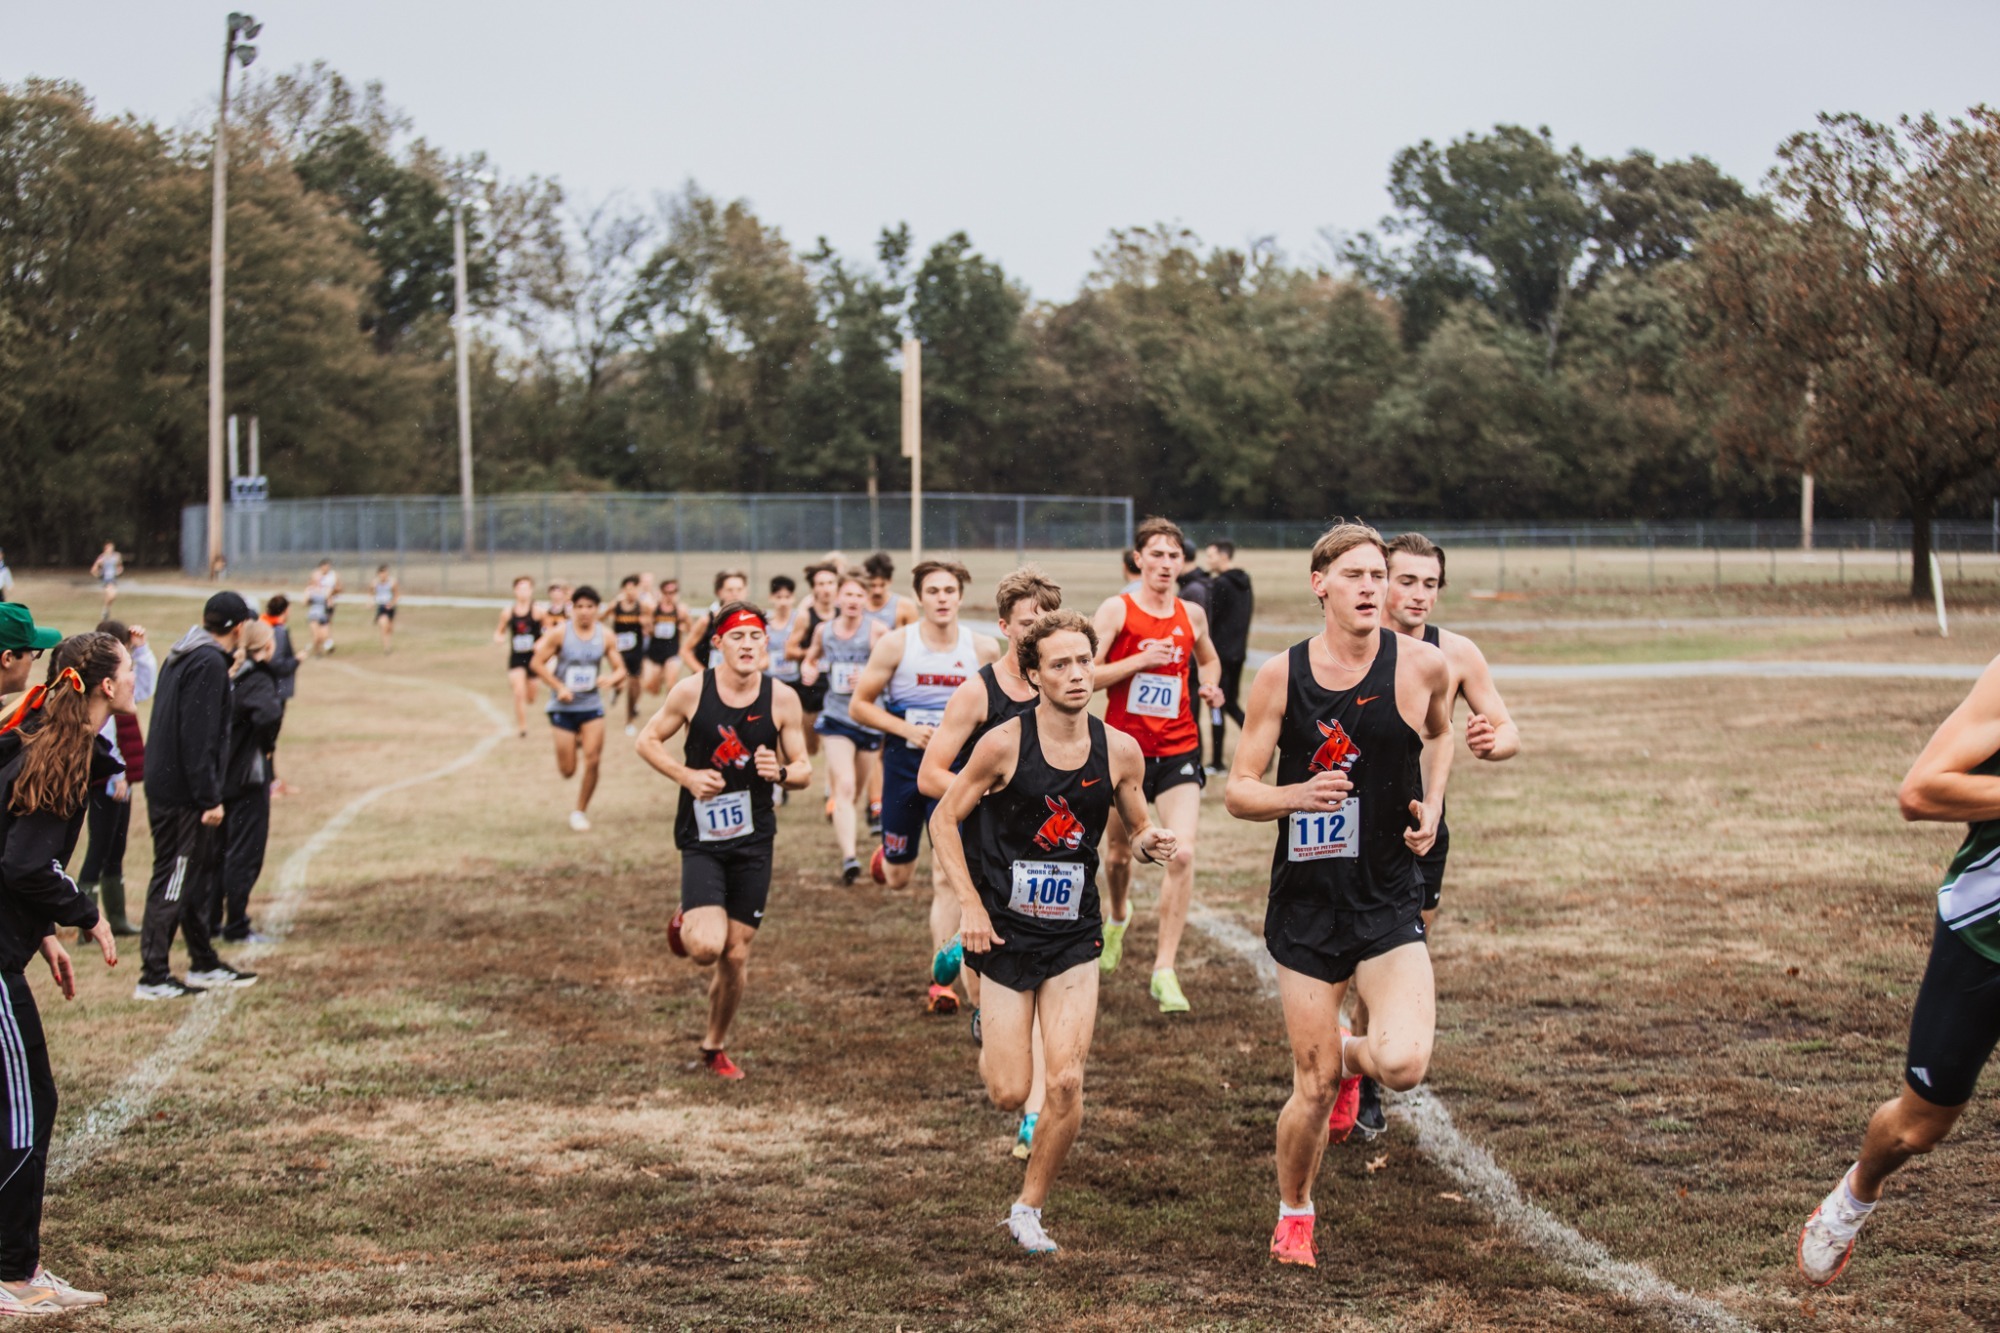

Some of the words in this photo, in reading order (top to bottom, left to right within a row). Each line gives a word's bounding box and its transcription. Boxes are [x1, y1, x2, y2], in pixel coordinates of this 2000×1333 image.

[1138, 685, 1171, 706] 270
[707, 804, 743, 829] 115
[1296, 814, 1345, 845] 112
[1027, 878, 1072, 904] 106
